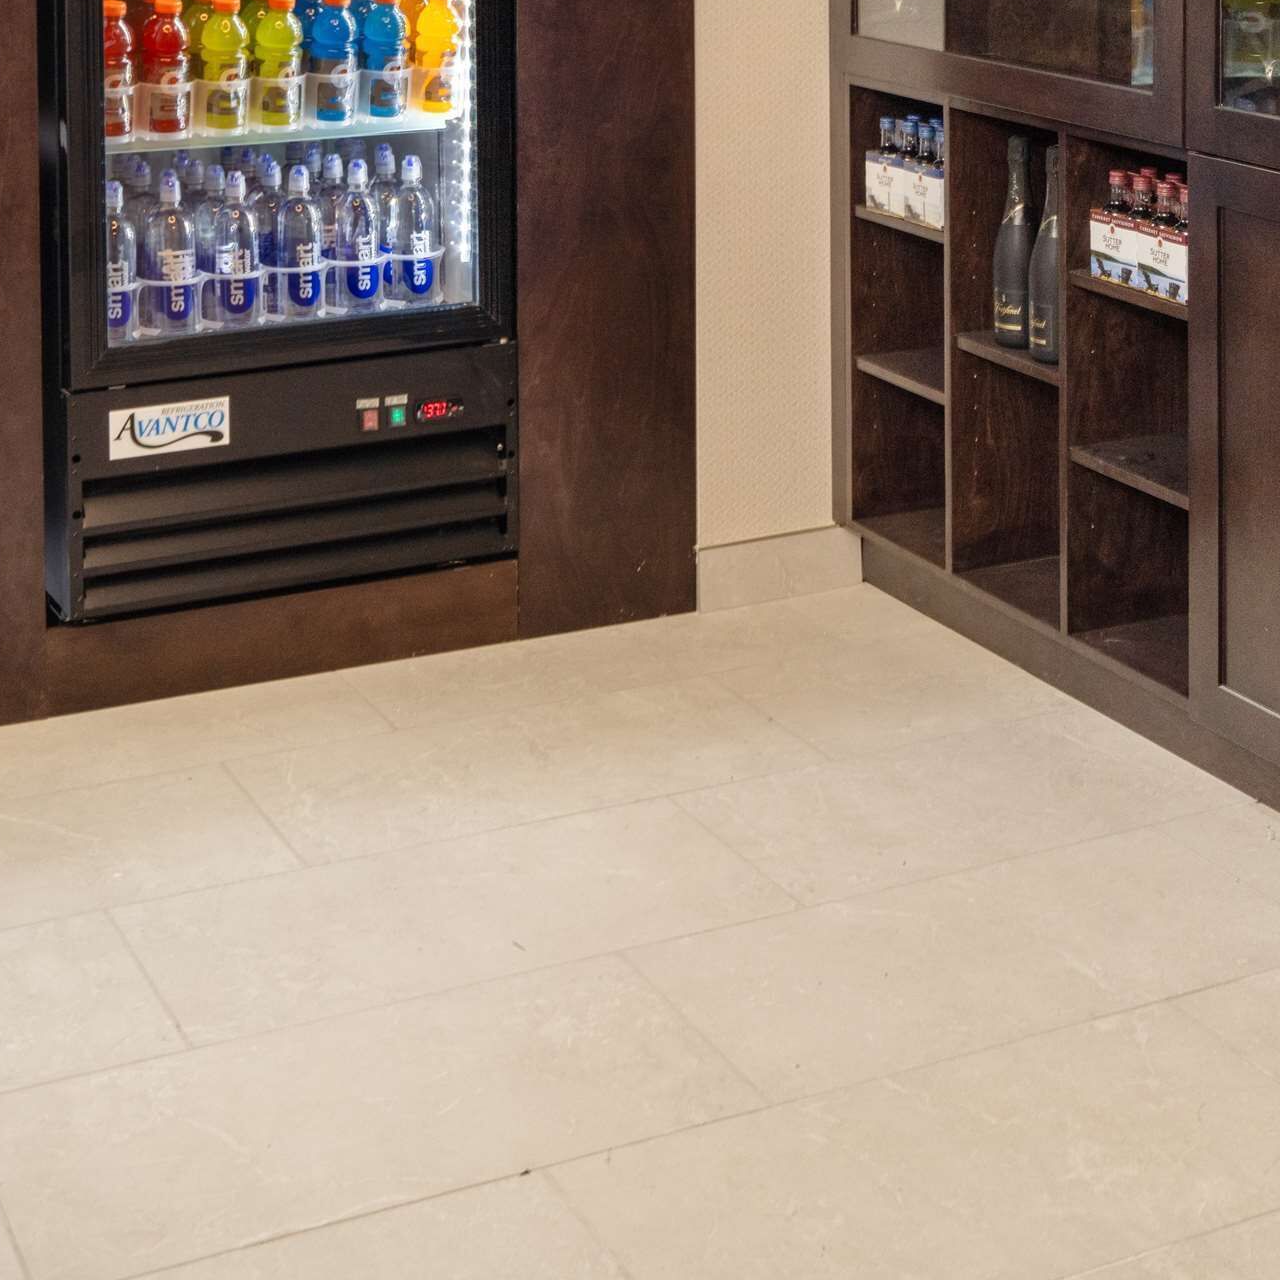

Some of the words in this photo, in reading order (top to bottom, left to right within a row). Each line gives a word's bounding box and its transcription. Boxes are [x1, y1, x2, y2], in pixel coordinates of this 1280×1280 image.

[299, 242, 314, 299] smart
[358, 234, 372, 291] smart
[414, 230, 428, 286] smart
[1152, 255, 1170, 267] HOME
[112, 409, 225, 448] AVANTCO
